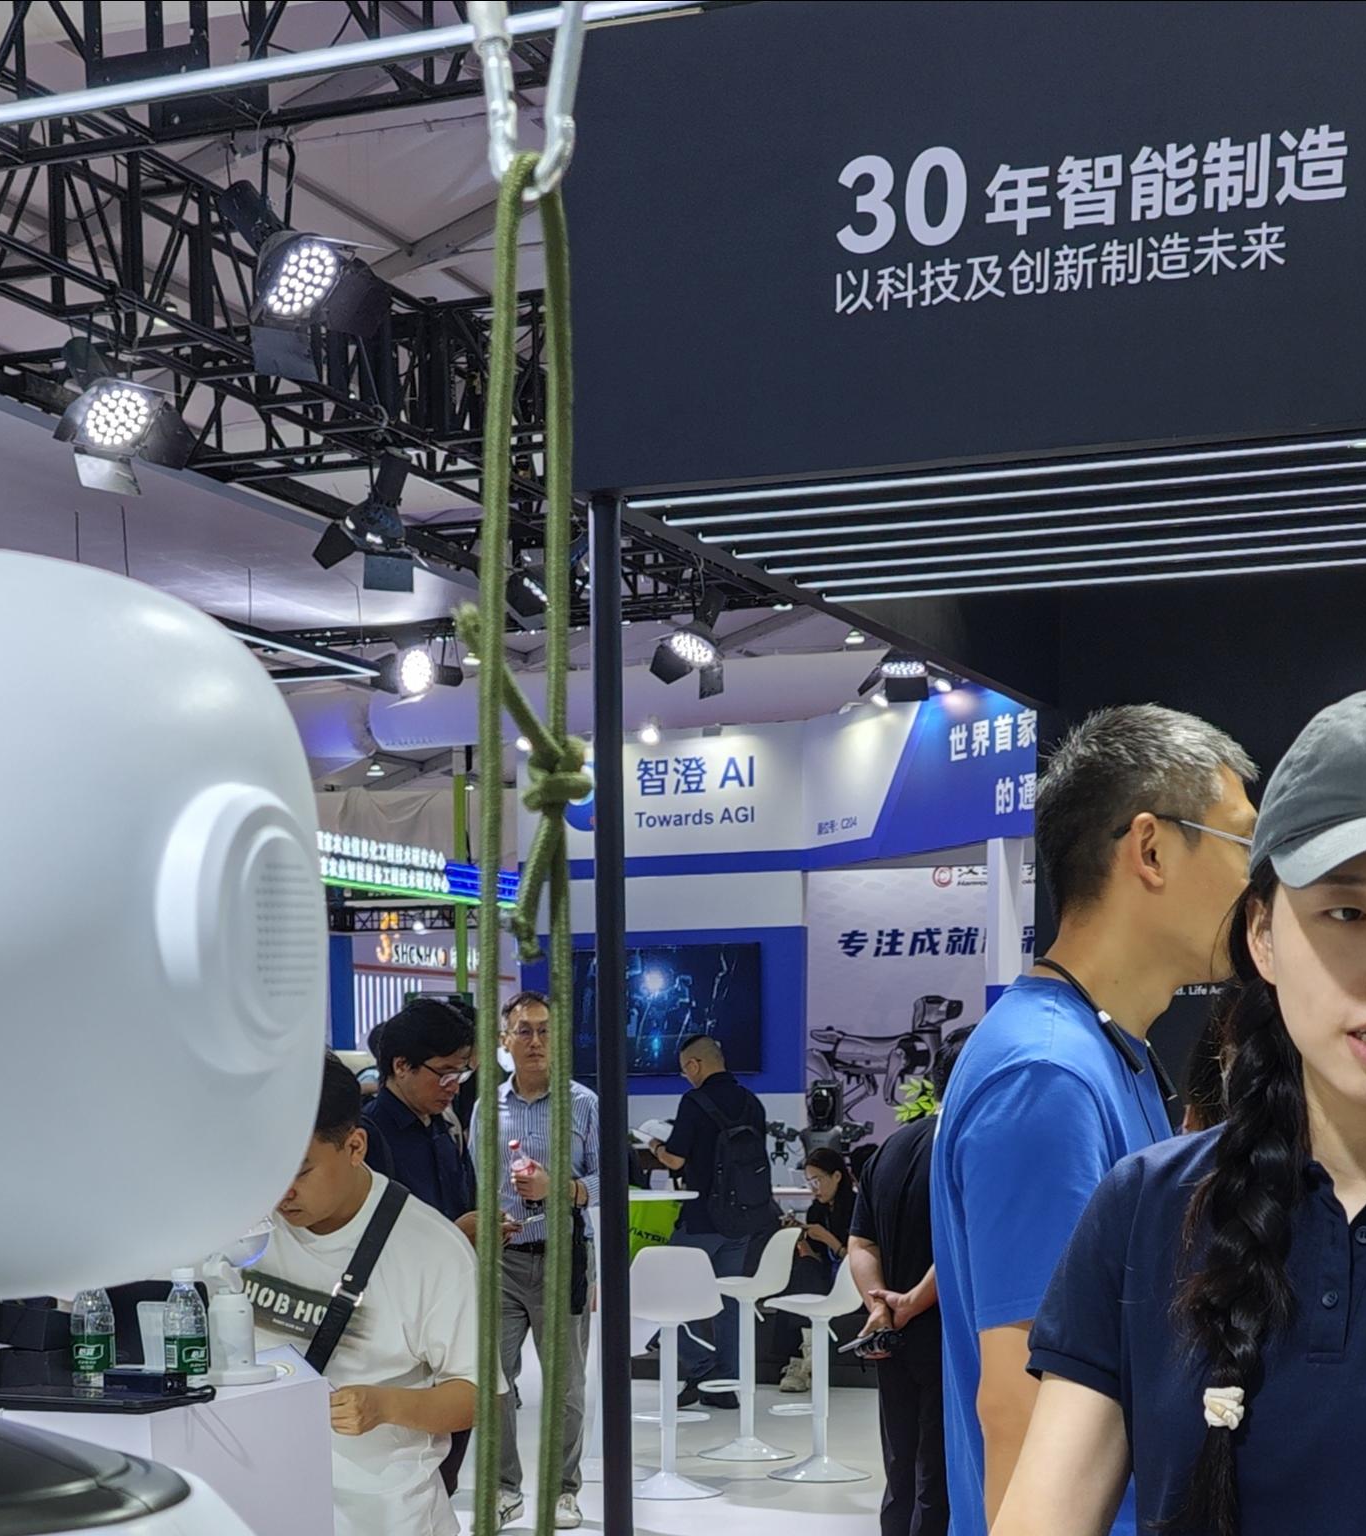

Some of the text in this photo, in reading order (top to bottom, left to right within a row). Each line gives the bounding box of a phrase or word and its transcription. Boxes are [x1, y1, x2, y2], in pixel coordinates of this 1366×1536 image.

[836, 124, 1348, 254] 30 年智能制造
[835, 221, 1286, 314] 以科技及创新制造未来
[950, 708, 1037, 762] 世界首家
[637, 755, 755, 796] 智澄 AI
[995, 772, 1037, 815] 的通
[634, 805, 755, 828] Towards AGI
